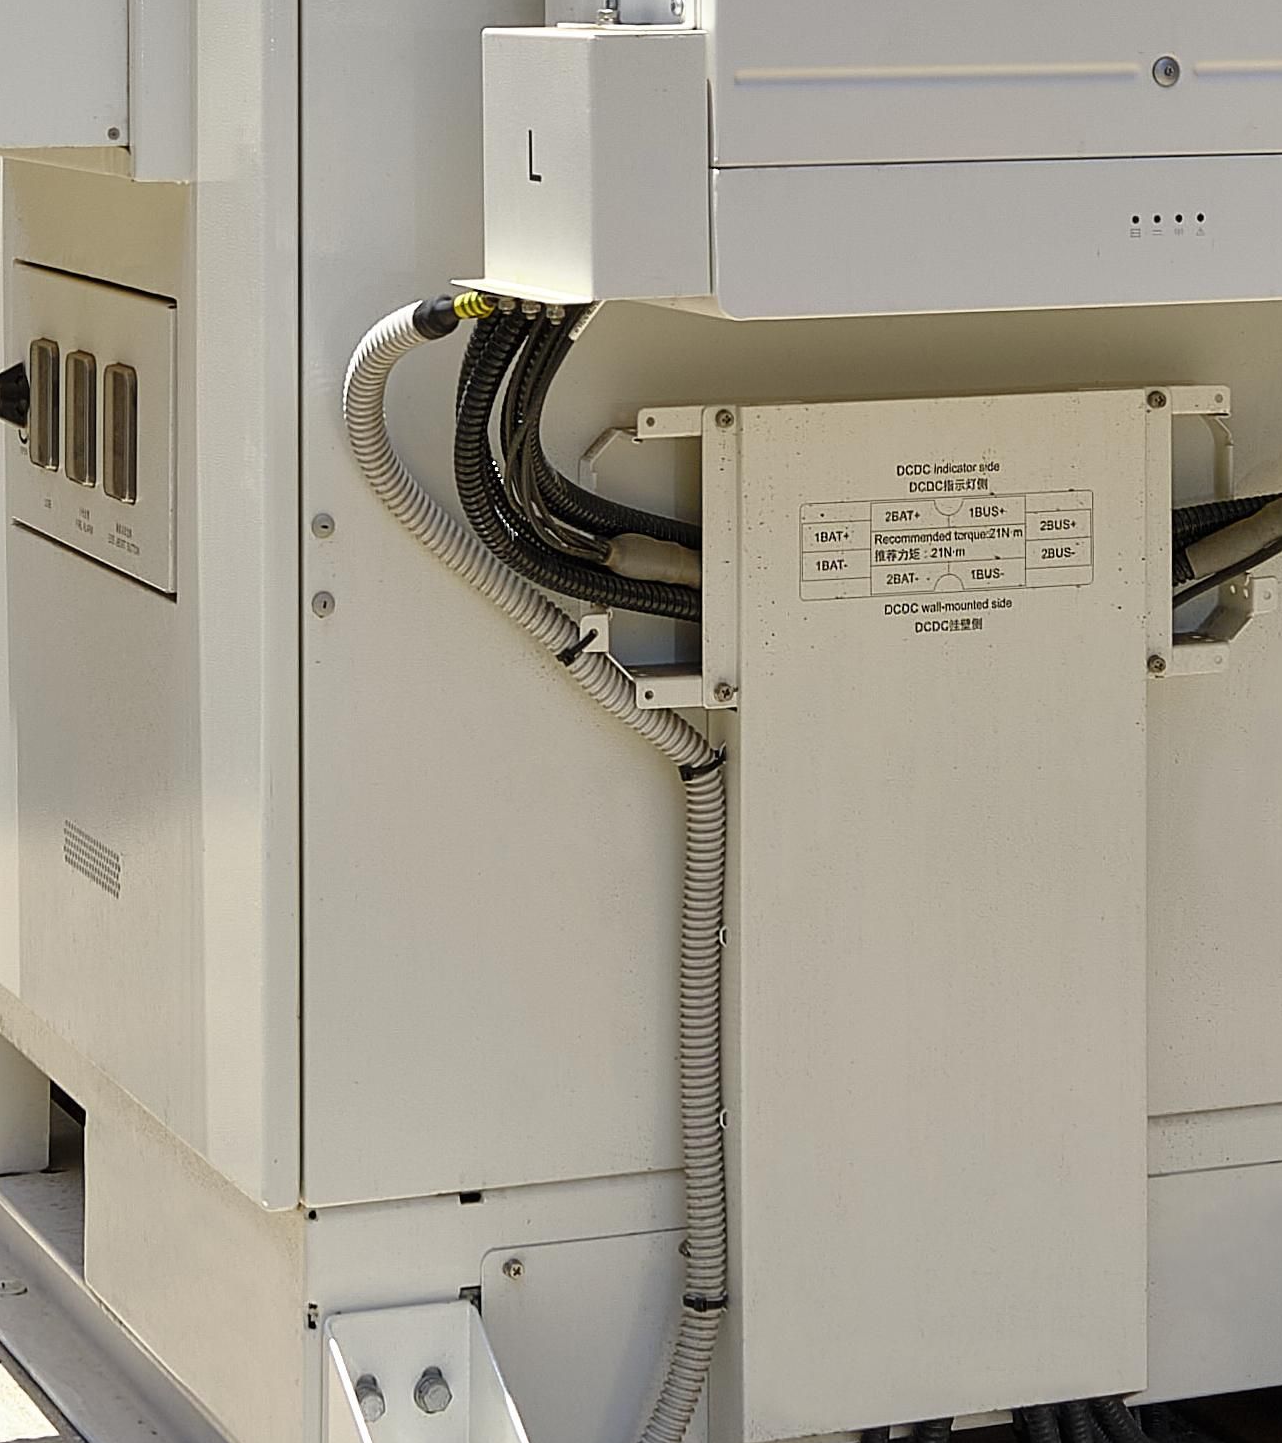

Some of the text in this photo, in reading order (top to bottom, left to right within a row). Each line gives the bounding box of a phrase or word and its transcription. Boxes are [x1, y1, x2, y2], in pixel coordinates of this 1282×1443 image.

[528, 129, 542, 182] L
[896, 464, 931, 477] DCDC
[979, 461, 1000, 473] side
[885, 510, 921, 523] 2BAT+
[969, 505, 1008, 518] 1BUS+
[1040, 519, 1077, 531] 2BUS+
[815, 531, 849, 543] 1BAT+
[874, 531, 952, 545] Recommended
[1041, 547, 1076, 559] 2BUS-
[816, 559, 848, 571] 1BAT-
[886, 573, 919, 585] 2BAT-
[971, 568, 1004, 579] 1BUS-
[884, 598, 1012, 615] DCDC wall-mounted side
